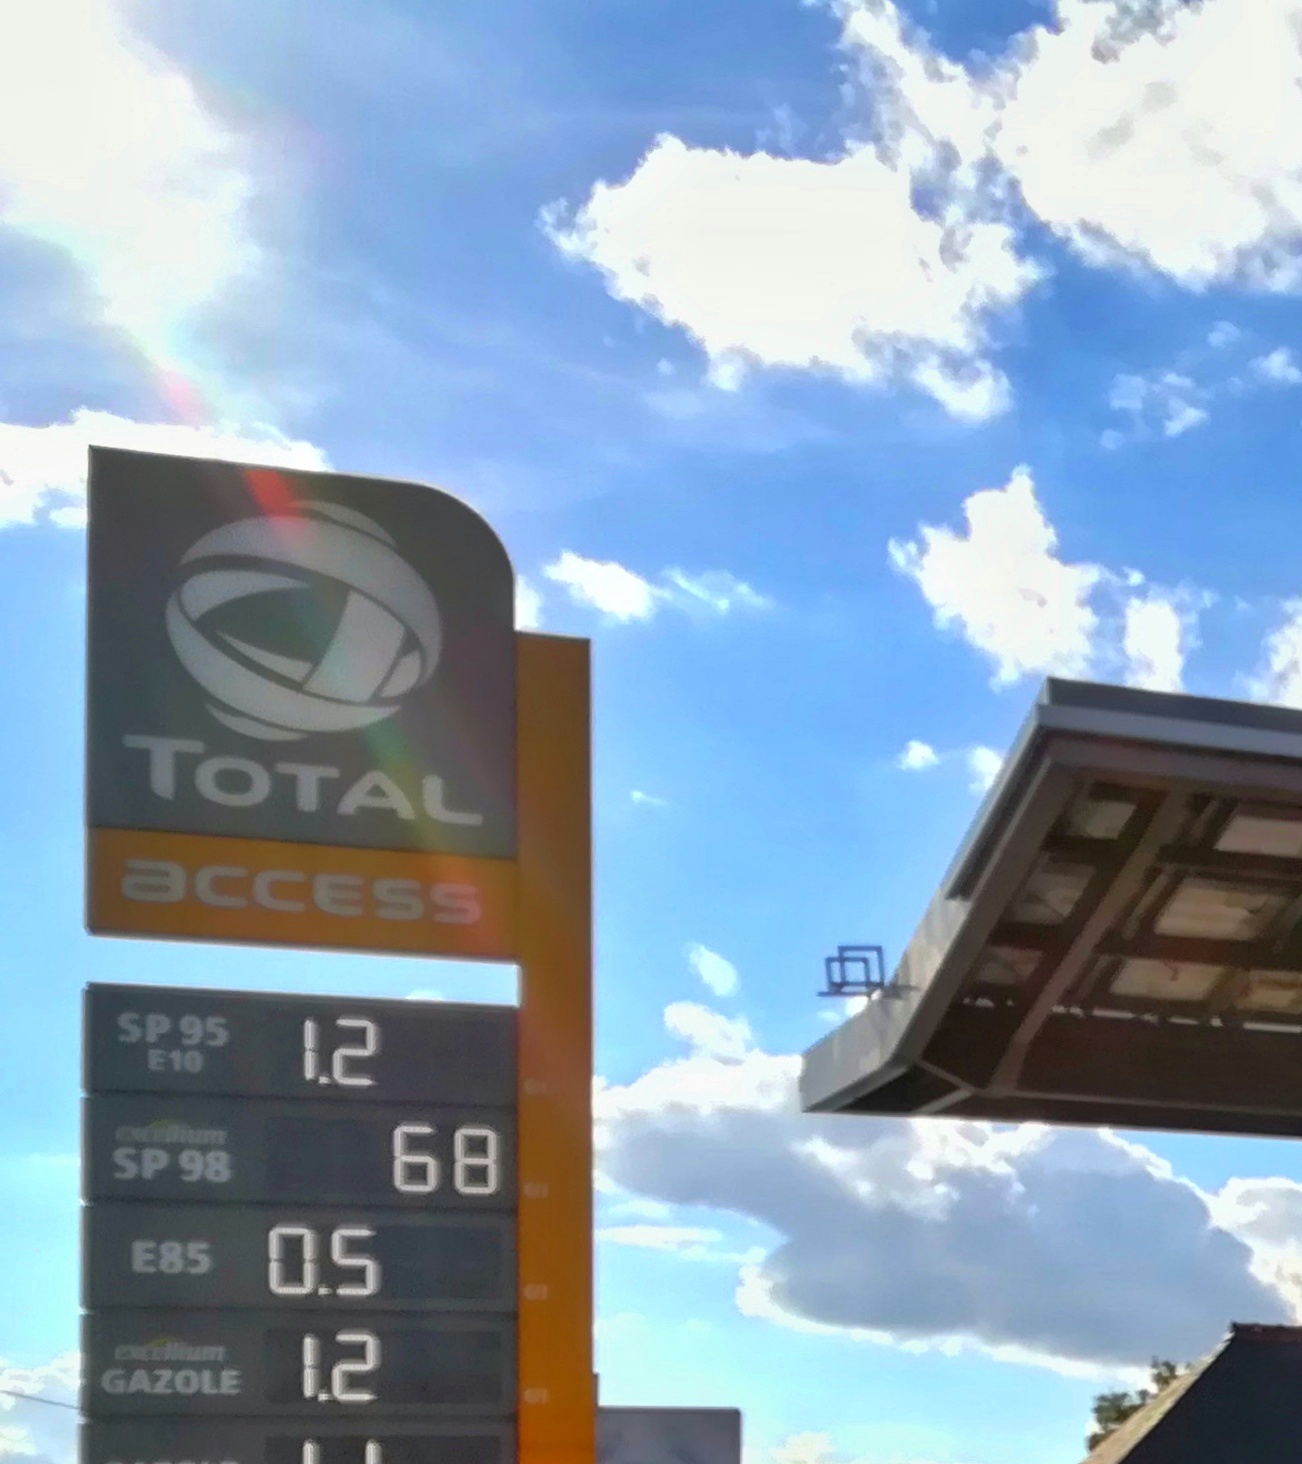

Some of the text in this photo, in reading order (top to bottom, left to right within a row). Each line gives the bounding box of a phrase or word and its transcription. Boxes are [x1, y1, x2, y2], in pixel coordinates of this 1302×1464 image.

[121, 734, 484, 827] TOTAL
[116, 1012, 230, 1048] SP 95
[147, 1049, 205, 1074] E10
[111, 1147, 232, 1184] SP 98
[130, 1239, 214, 1275] E85
[101, 1369, 242, 1396] GAZOLE
